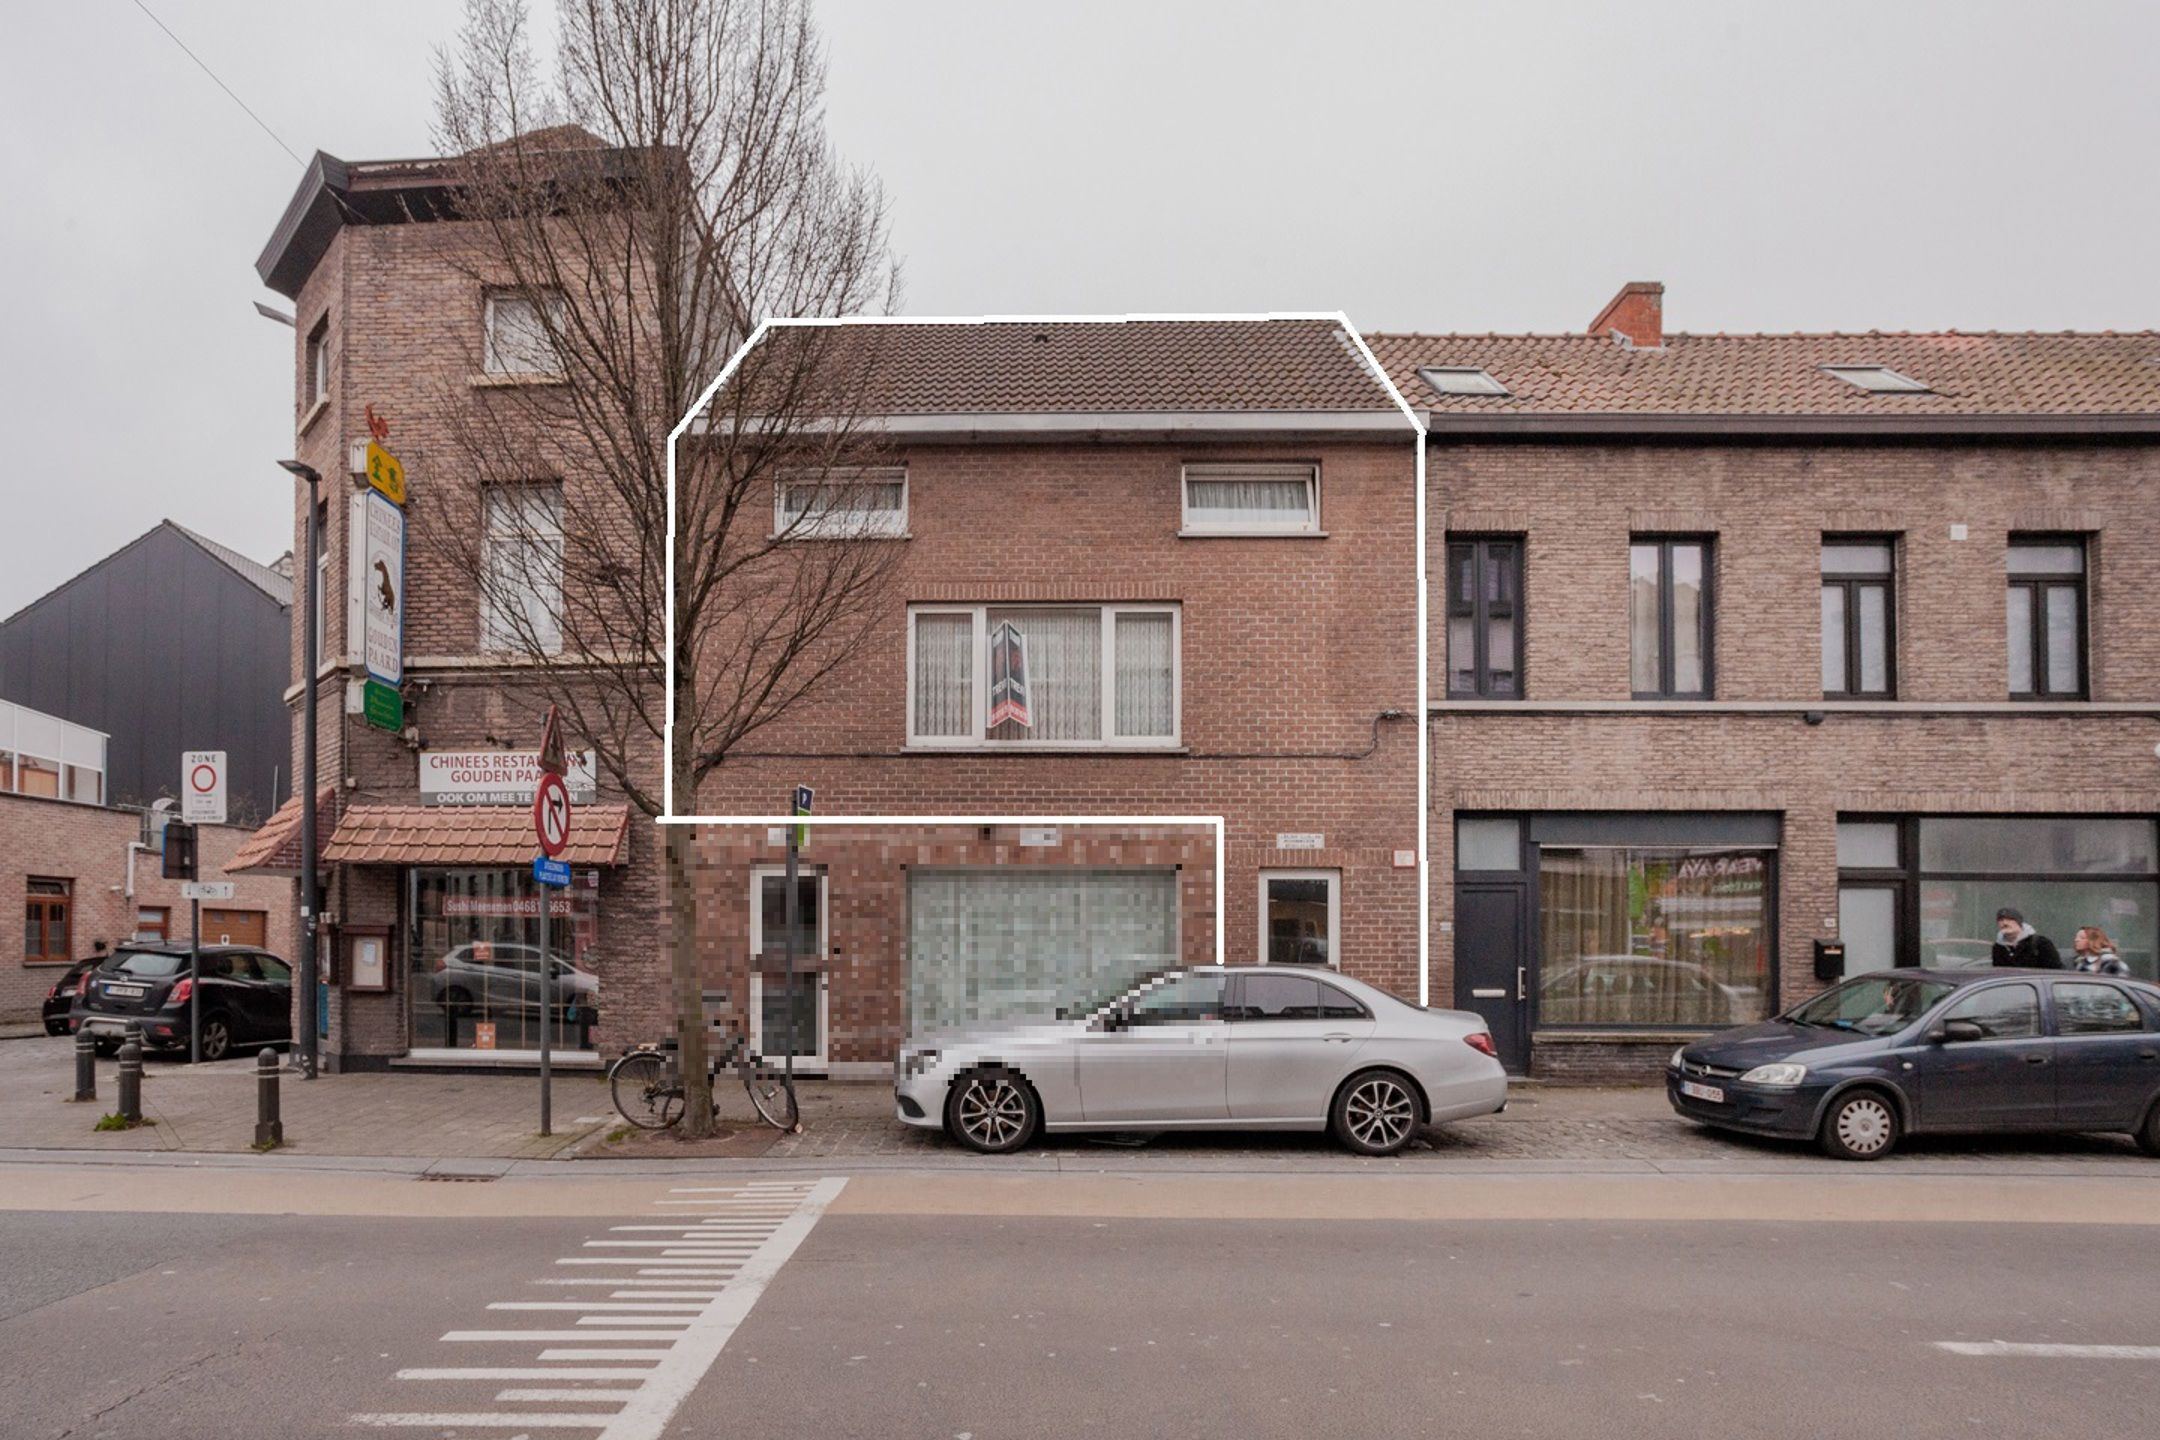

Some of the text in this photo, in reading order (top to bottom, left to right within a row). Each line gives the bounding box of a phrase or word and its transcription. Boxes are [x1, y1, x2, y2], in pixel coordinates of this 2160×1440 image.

[367, 645, 398, 673] PAARD
[191, 754, 216, 763] ZONE
[430, 755, 489, 769] CHINEES
[451, 770, 543, 783] GOUDEN PAA
[437, 792, 532, 802] OOK OM MEE TE
